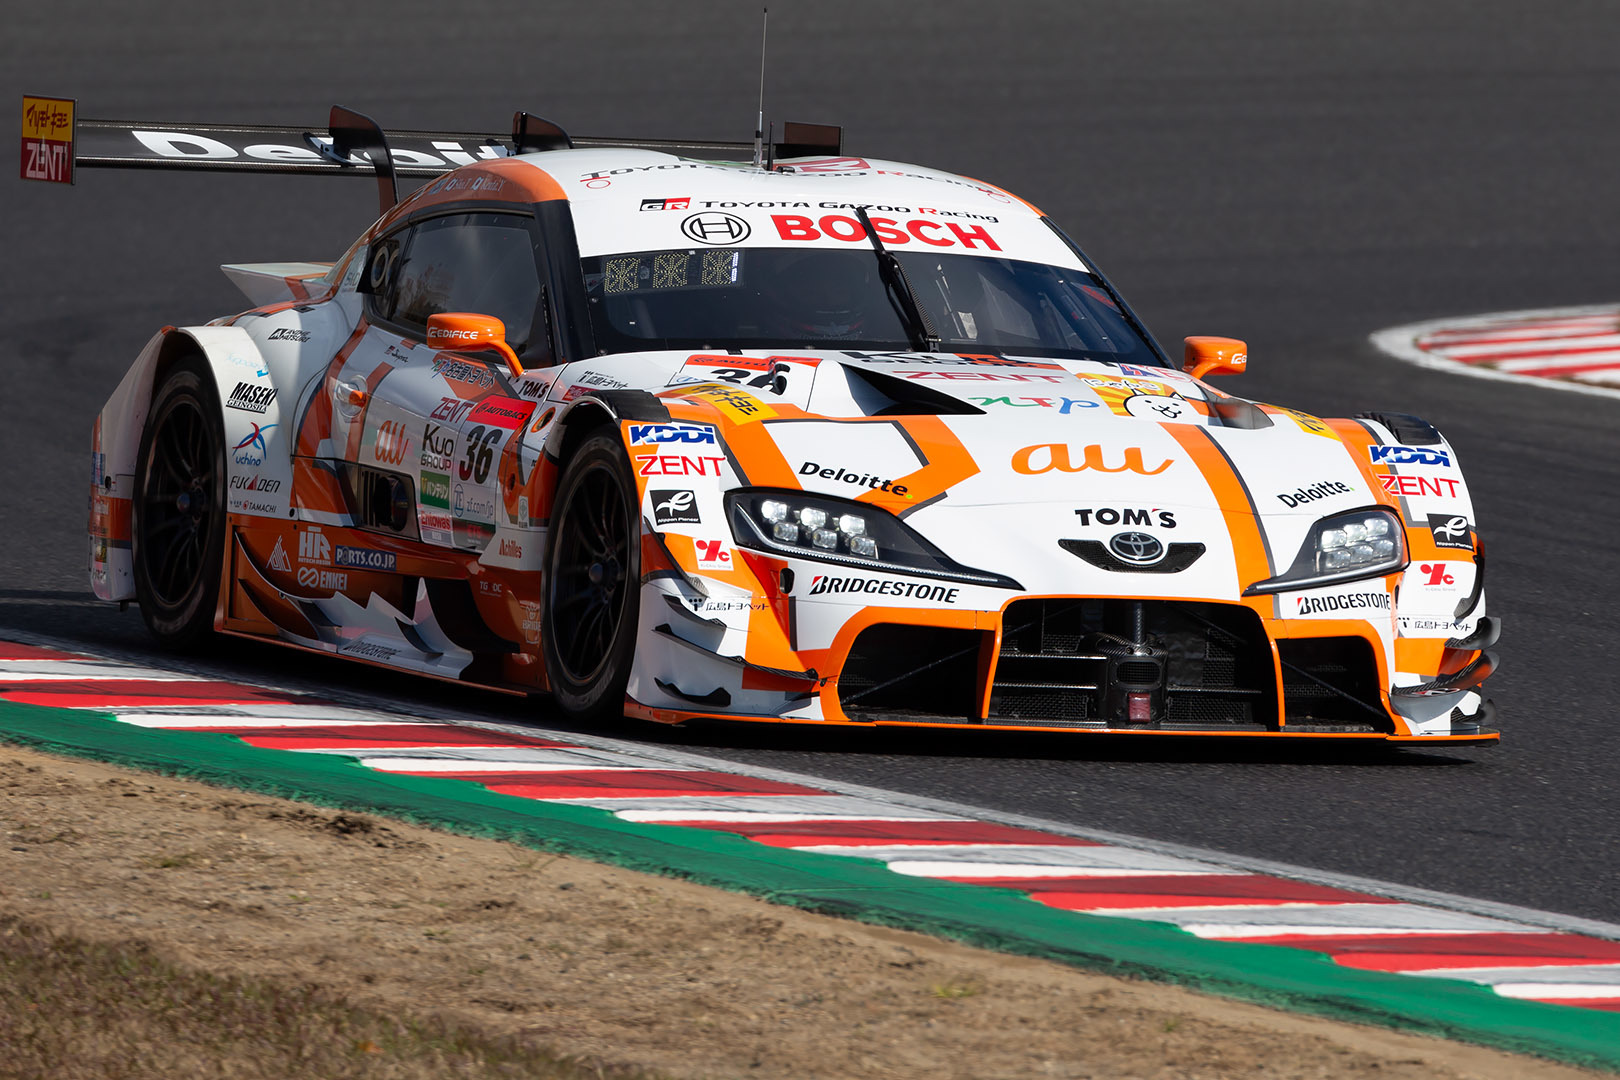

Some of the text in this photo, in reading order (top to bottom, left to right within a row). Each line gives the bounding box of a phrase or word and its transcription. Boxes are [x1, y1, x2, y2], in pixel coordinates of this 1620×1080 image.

[700, 201, 810, 209] TOYOTA
[819, 201, 911, 213] GAZOO
[918, 207, 999, 223] Racing
[770, 214, 1003, 251] BOSCH
[437, 329, 479, 340] EDIFICE
[892, 371, 1065, 383] ZENT
[230, 382, 278, 406] MASEKI
[518, 381, 550, 398] TOM'S
[227, 399, 267, 412] GEINOSHA
[429, 397, 475, 423] ZENT
[485, 405, 528, 420] AUTOBACS
[375, 420, 409, 465] au
[630, 425, 715, 445] KDDI
[236, 452, 261, 466] uchino
[421, 454, 451, 471] GROUP
[459, 425, 503, 484] 36
[1011, 443, 1175, 475] au
[1370, 446, 1450, 467] KDDI
[637, 455, 727, 476] ZENT
[1377, 474, 1460, 498] ZENT
[249, 502, 277, 513] TAMACHI
[1074, 508, 1177, 528] TOM'S
[320, 571, 347, 590] ENKEI
[809, 576, 960, 603] BRIDGESTONE
[1297, 592, 1390, 615] BRIDGESTONE
